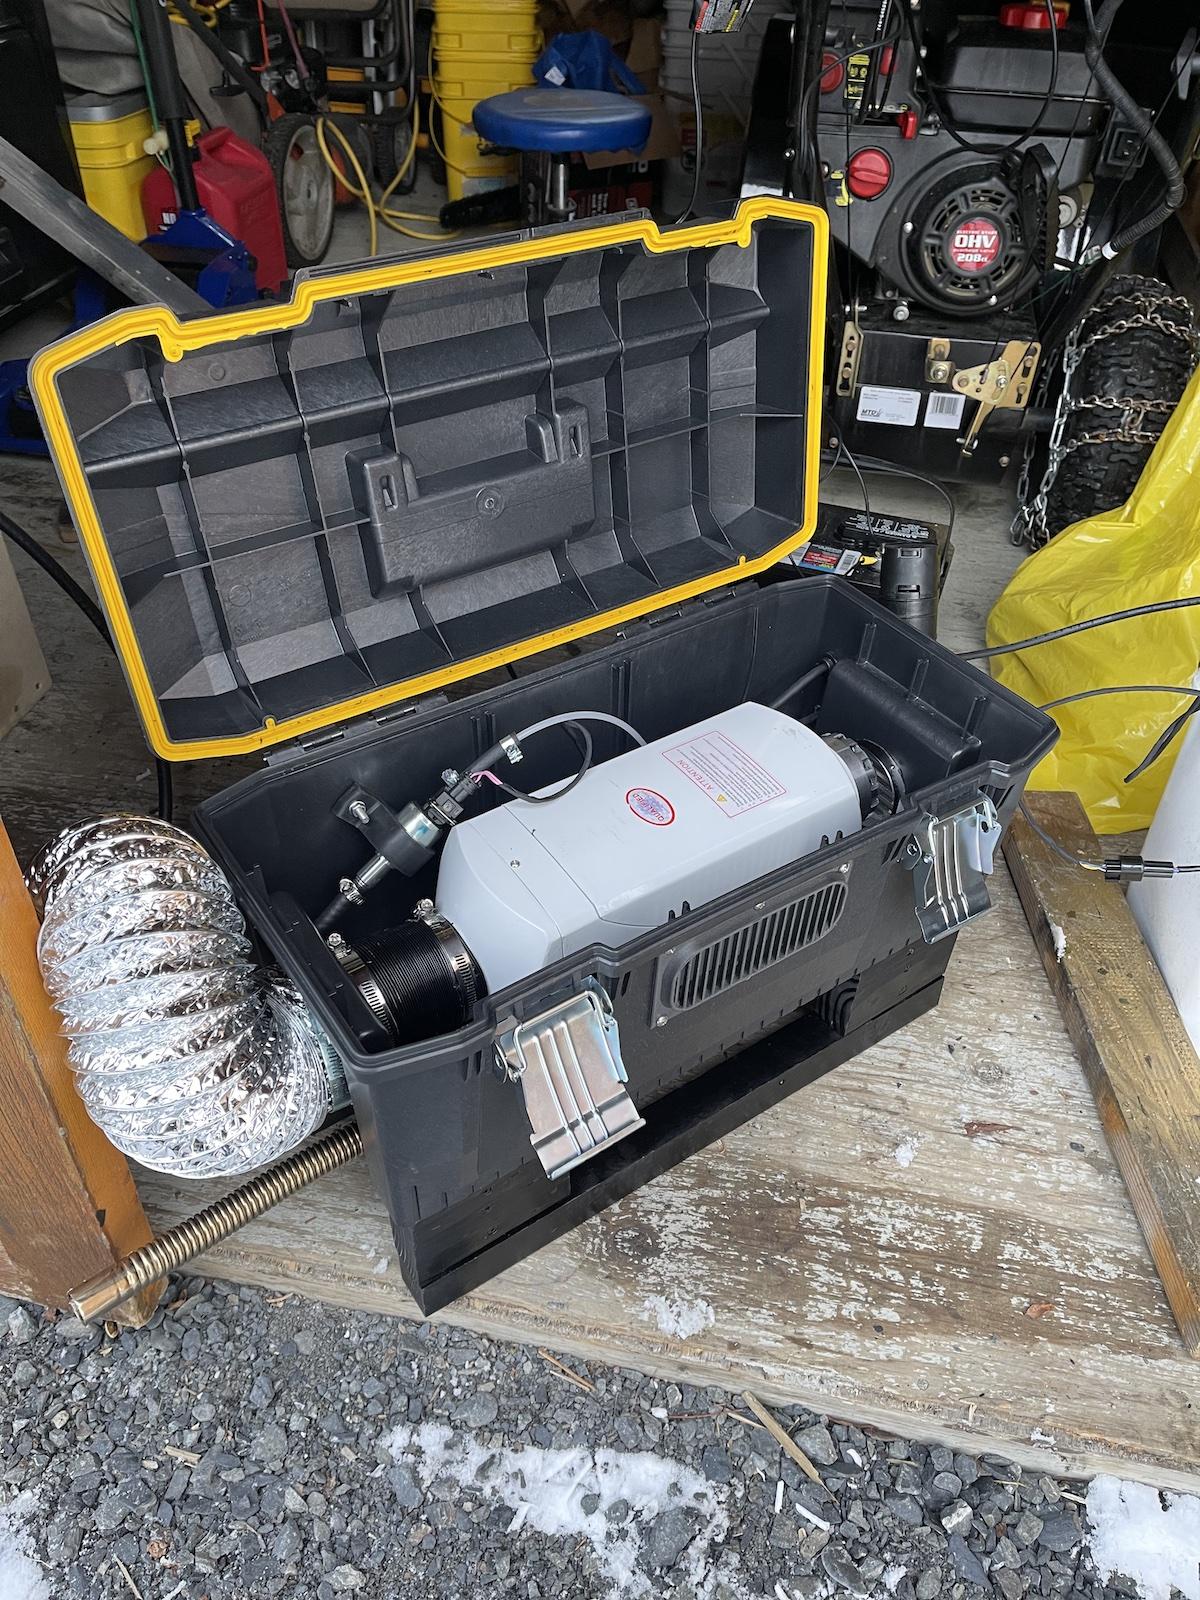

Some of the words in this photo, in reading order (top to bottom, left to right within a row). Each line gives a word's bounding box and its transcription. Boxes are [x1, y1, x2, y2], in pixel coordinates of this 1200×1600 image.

[955, 234, 997, 248] OHV
[676, 758, 713, 791] ATTENTION
[632, 792, 665, 822] QUALIFIED
